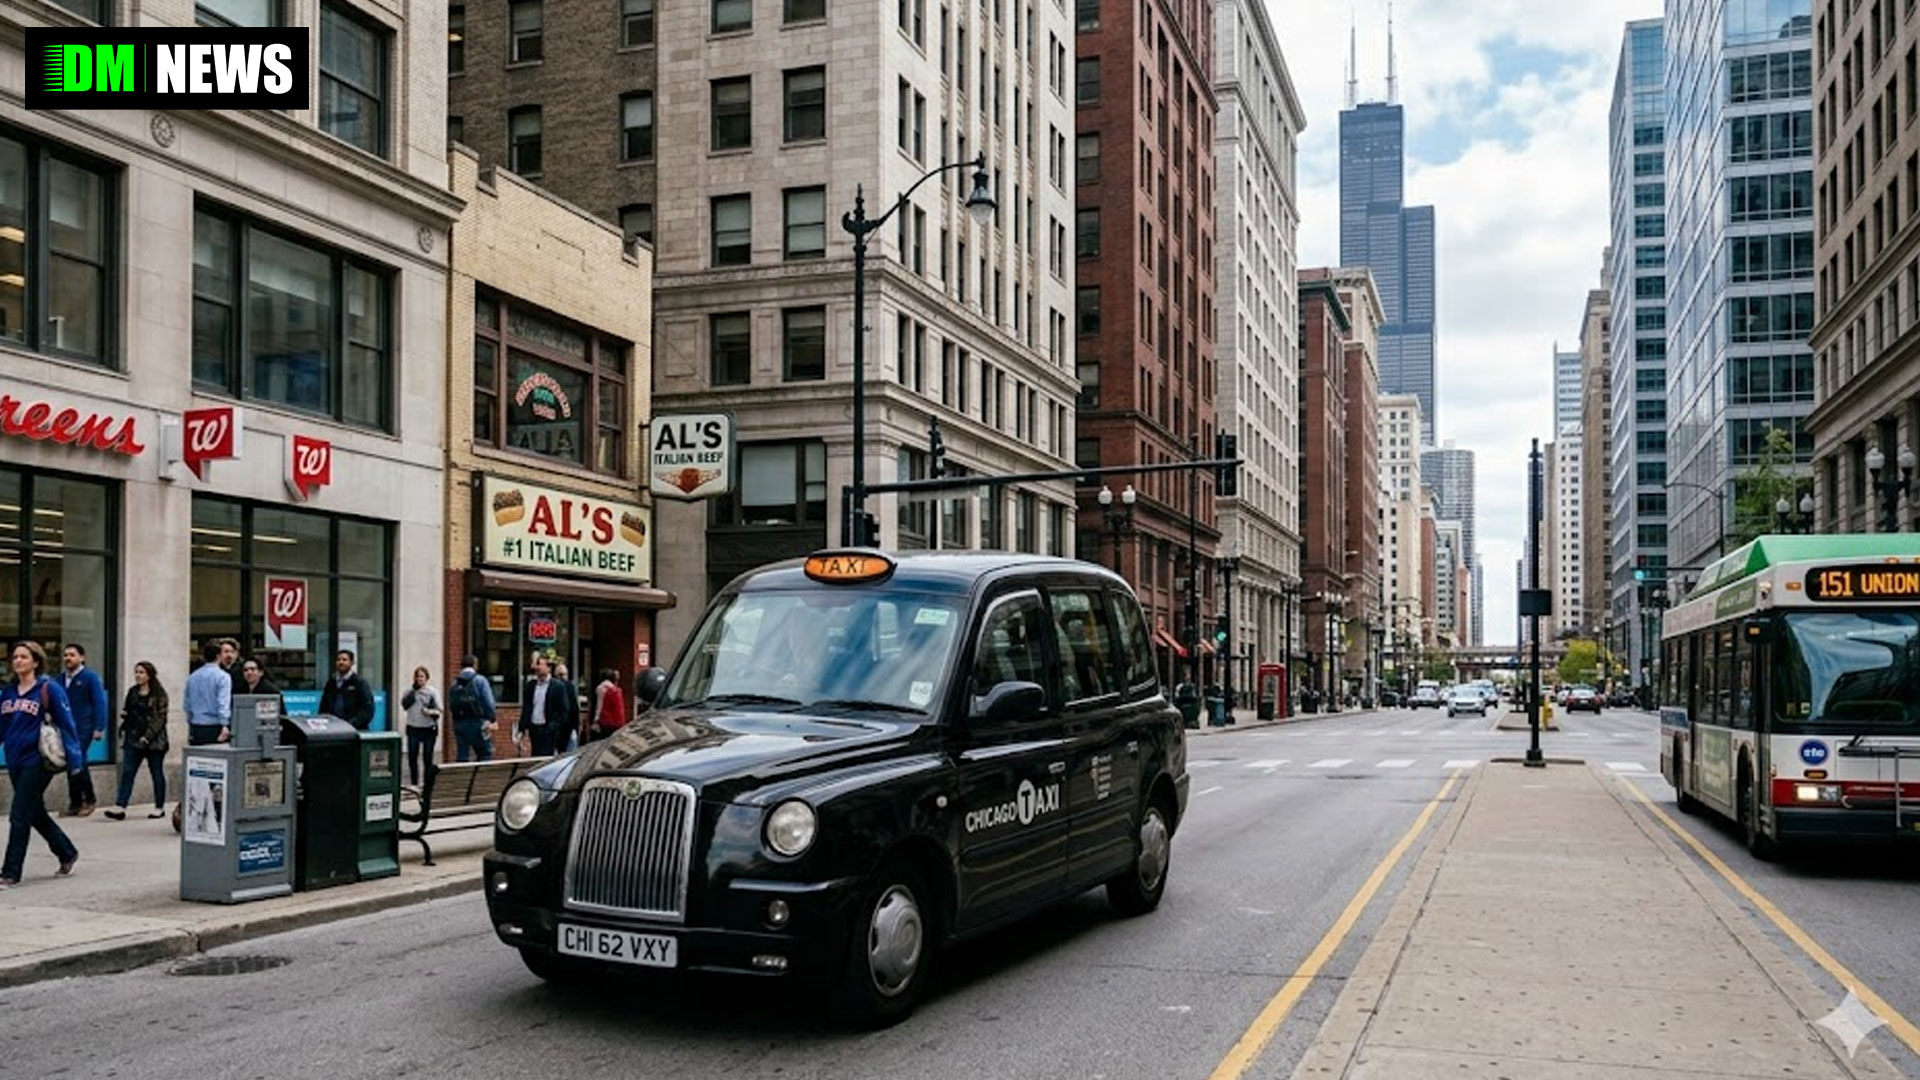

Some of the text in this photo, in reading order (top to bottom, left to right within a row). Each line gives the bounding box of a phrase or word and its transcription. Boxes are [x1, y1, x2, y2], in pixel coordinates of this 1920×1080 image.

[654, 421, 722, 450] AL'S
[654, 451, 724, 465] ITALIAN BEEF
[528, 495, 614, 545] AL'S
[502, 537, 635, 572] #1 ITALIAN BEEF
[819, 558, 866, 574] TAXI
[1819, 571, 1920, 597] 151 UNION
[965, 781, 1059, 833] CHICAGO TAXI
[565, 926, 671, 962] CHI 62 VXY
